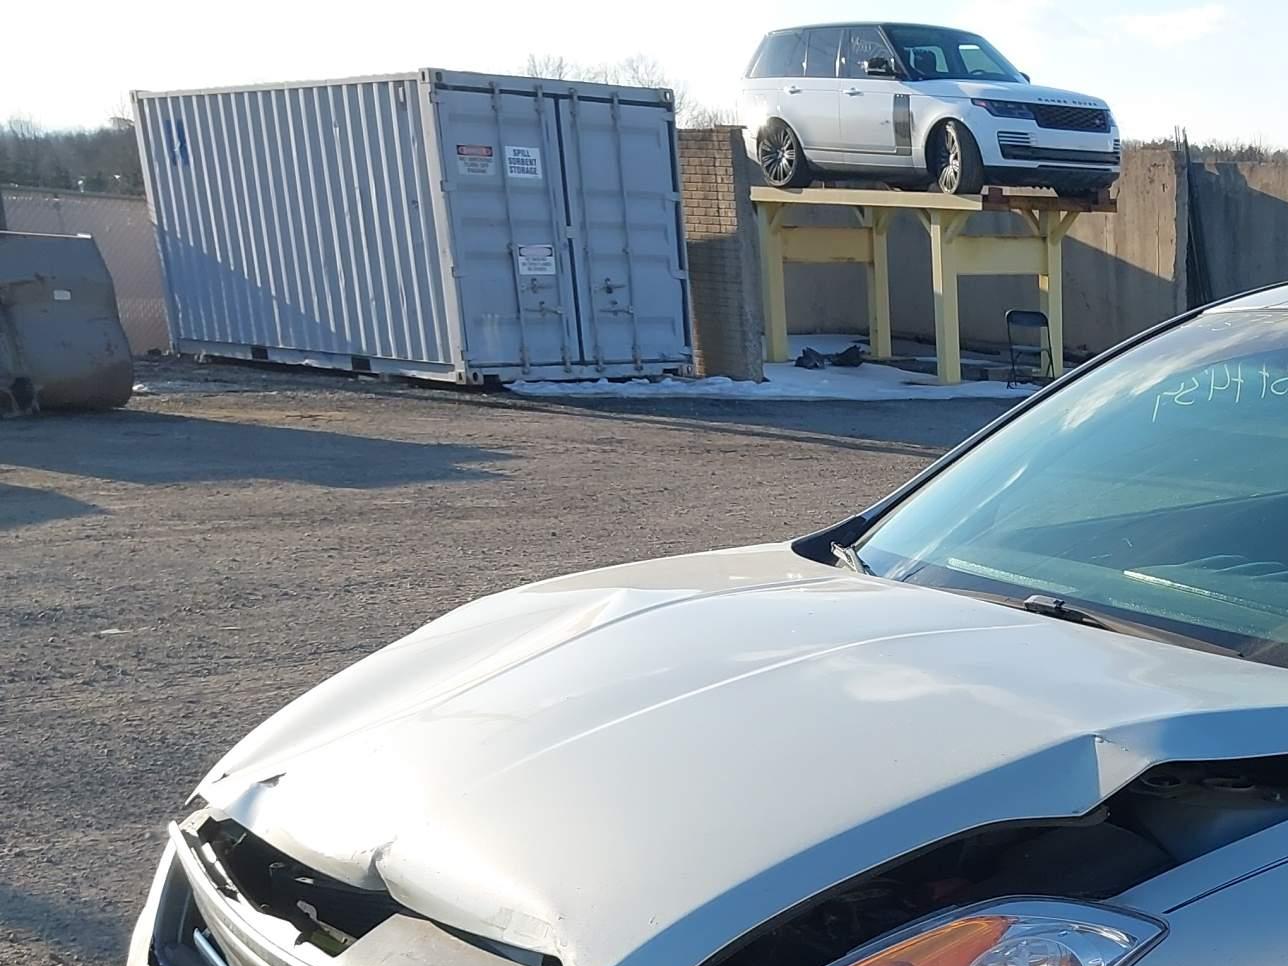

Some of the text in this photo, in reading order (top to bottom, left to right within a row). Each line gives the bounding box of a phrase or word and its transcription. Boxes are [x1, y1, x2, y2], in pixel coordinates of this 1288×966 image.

[513, 149, 530, 157] SPILL
[509, 157, 537, 166] SORBENT
[510, 166, 538, 175] STORAGE
